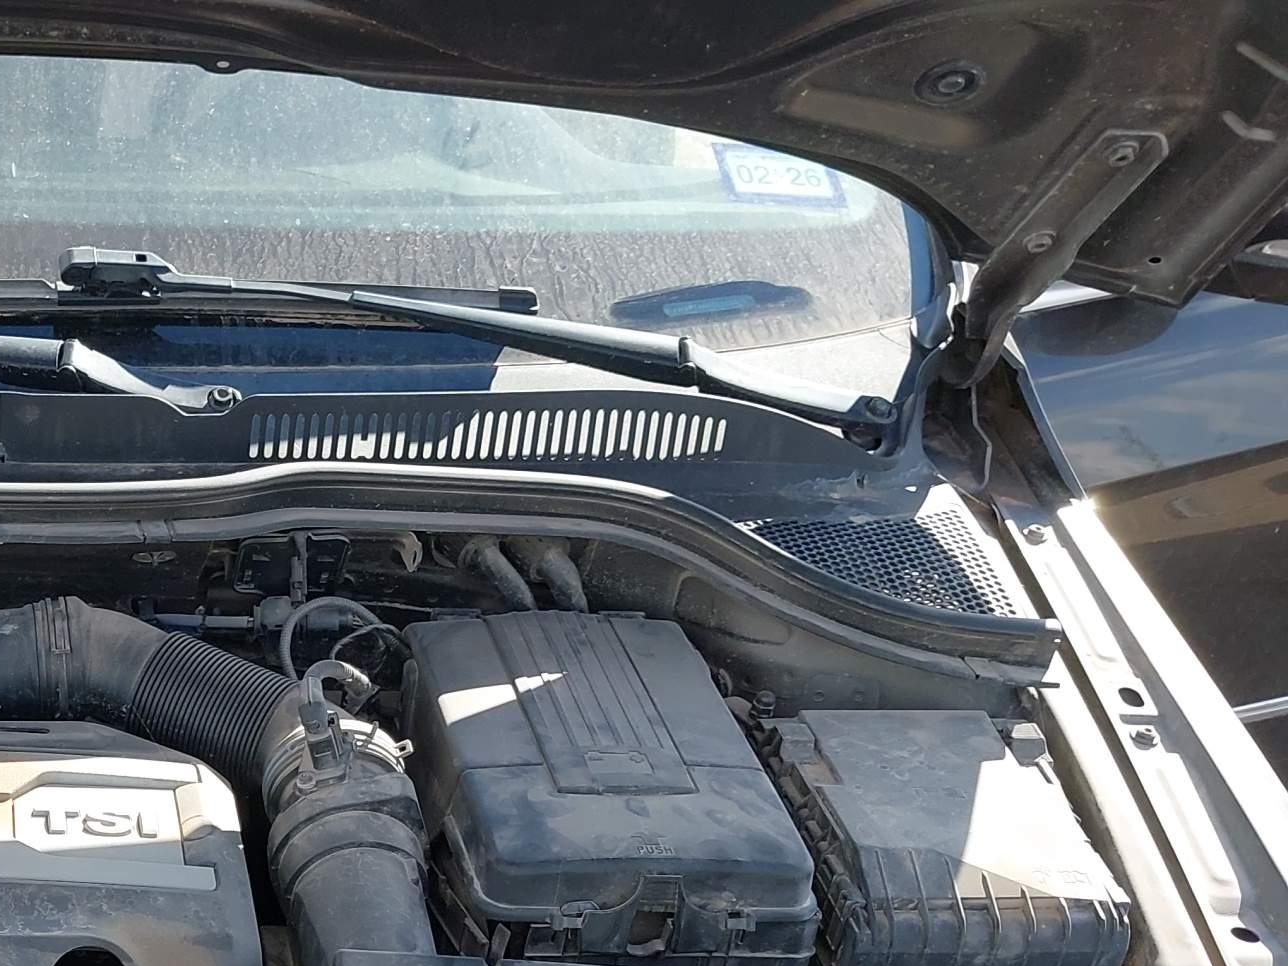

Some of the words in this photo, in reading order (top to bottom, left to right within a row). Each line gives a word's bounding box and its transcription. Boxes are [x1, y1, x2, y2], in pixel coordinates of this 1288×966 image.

[736, 164, 770, 185] 02
[785, 167, 822, 188] 26
[30, 805, 158, 839] TSI
[637, 845, 674, 855] PUSH
